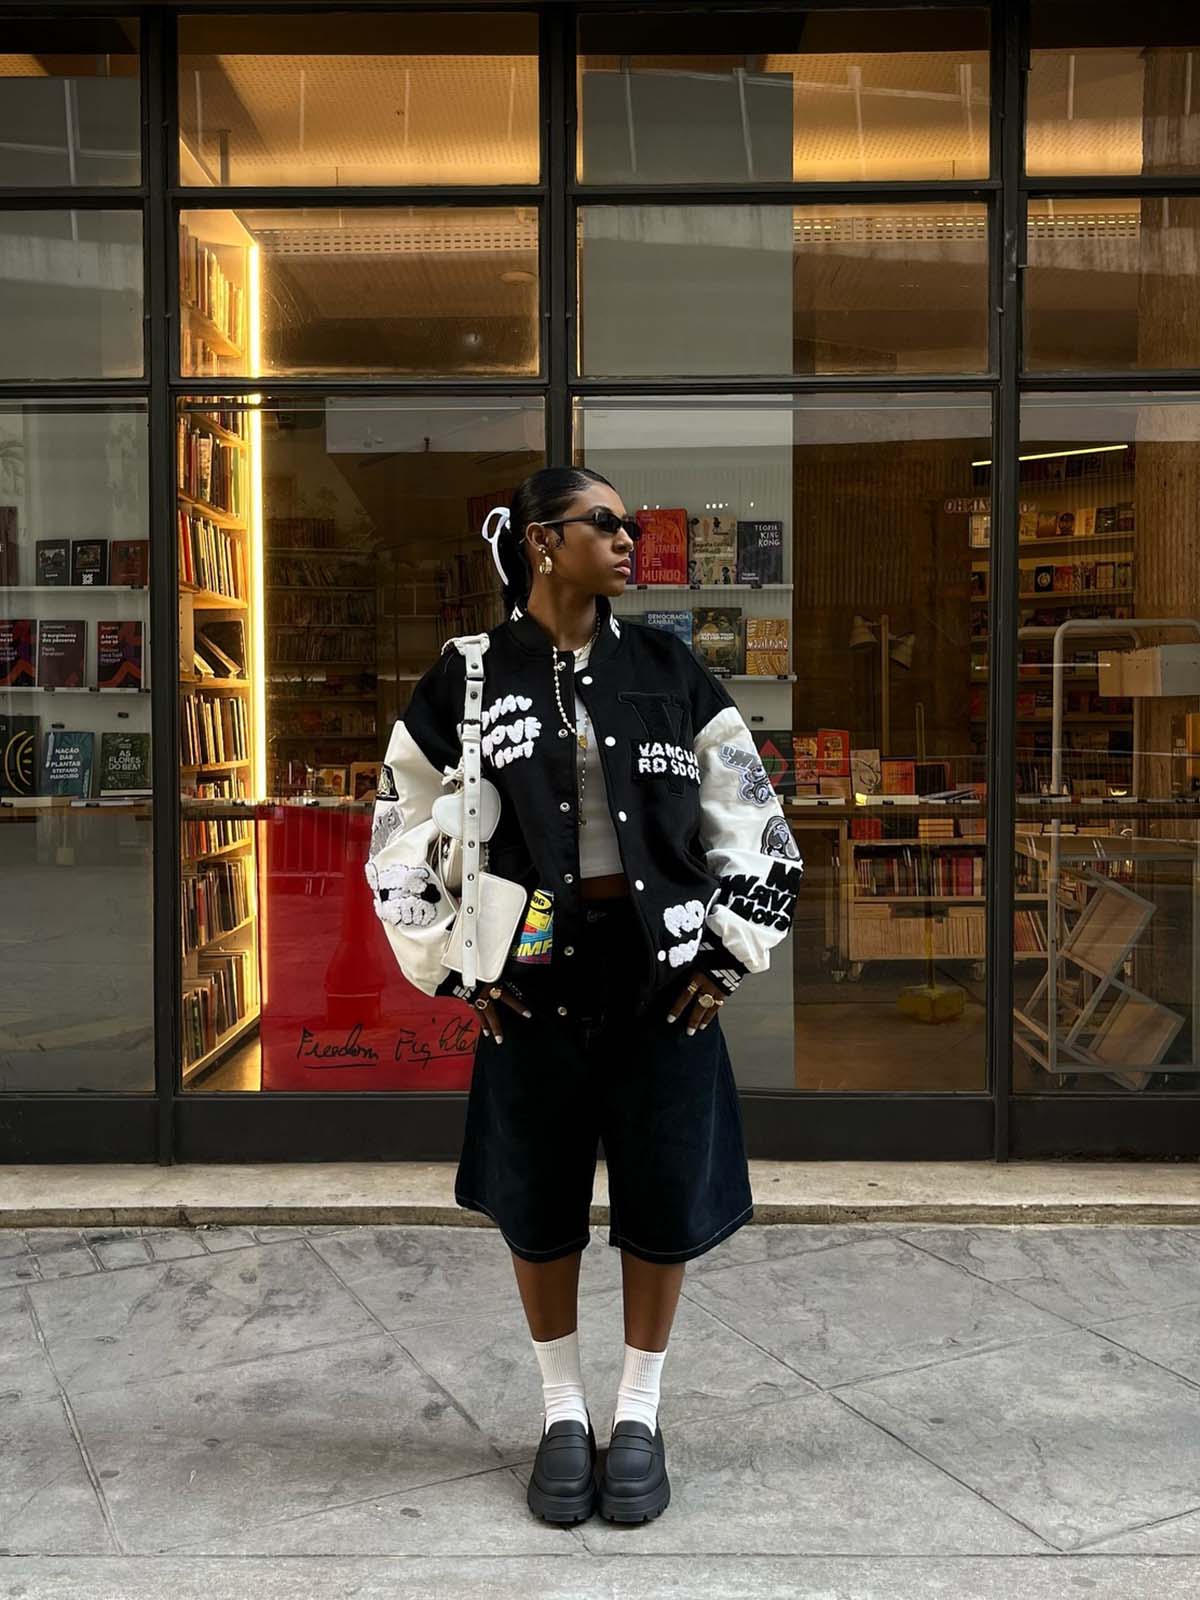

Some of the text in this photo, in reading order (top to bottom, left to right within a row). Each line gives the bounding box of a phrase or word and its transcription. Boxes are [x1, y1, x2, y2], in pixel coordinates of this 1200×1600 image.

[758, 539, 781, 548] KONG
[108, 756, 142, 764] FLORES
[297, 1023, 379, 1061] Freedom
